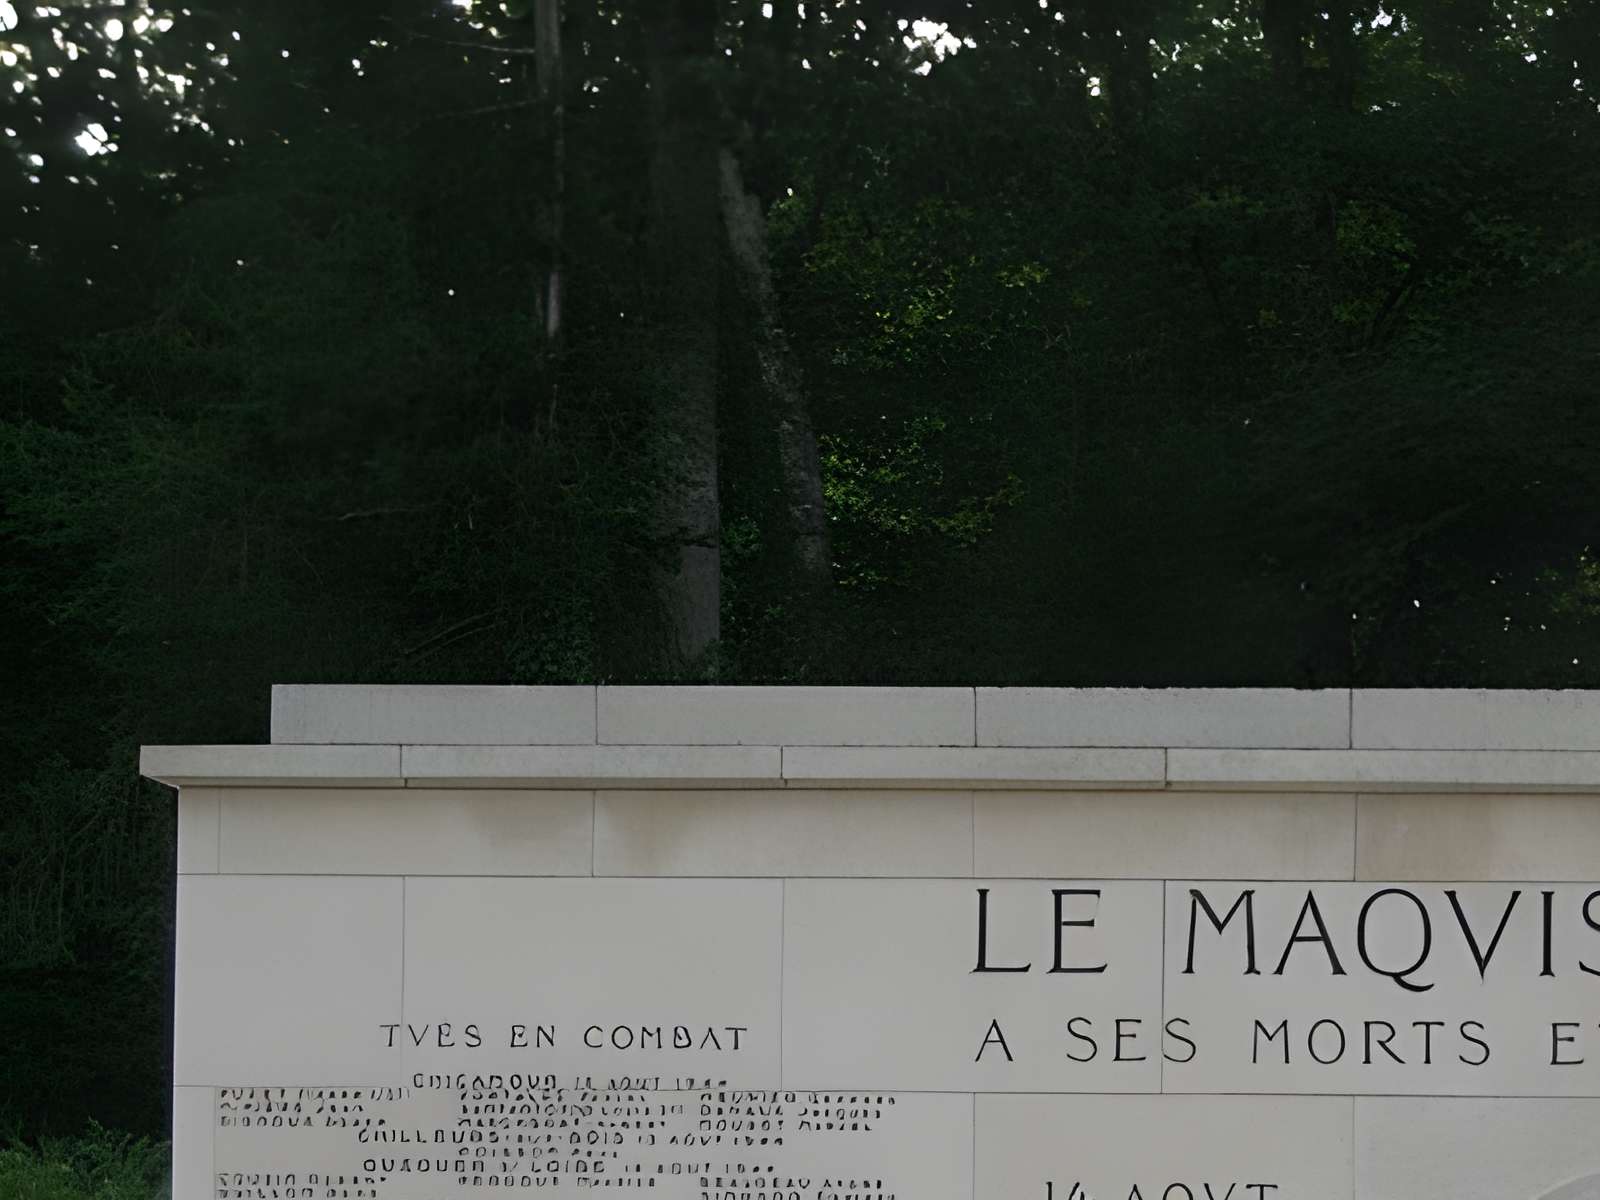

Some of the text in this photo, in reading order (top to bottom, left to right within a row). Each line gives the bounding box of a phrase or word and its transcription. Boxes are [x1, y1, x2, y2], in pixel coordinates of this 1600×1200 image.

[969, 888, 1109, 974] LE
[510, 1024, 555, 1048] EN
[583, 1024, 748, 1050] COMBAT
[974, 1019, 1014, 1063] A
[1066, 1017, 1197, 1064] SES
[1251, 1019, 1491, 1066] MORTS
